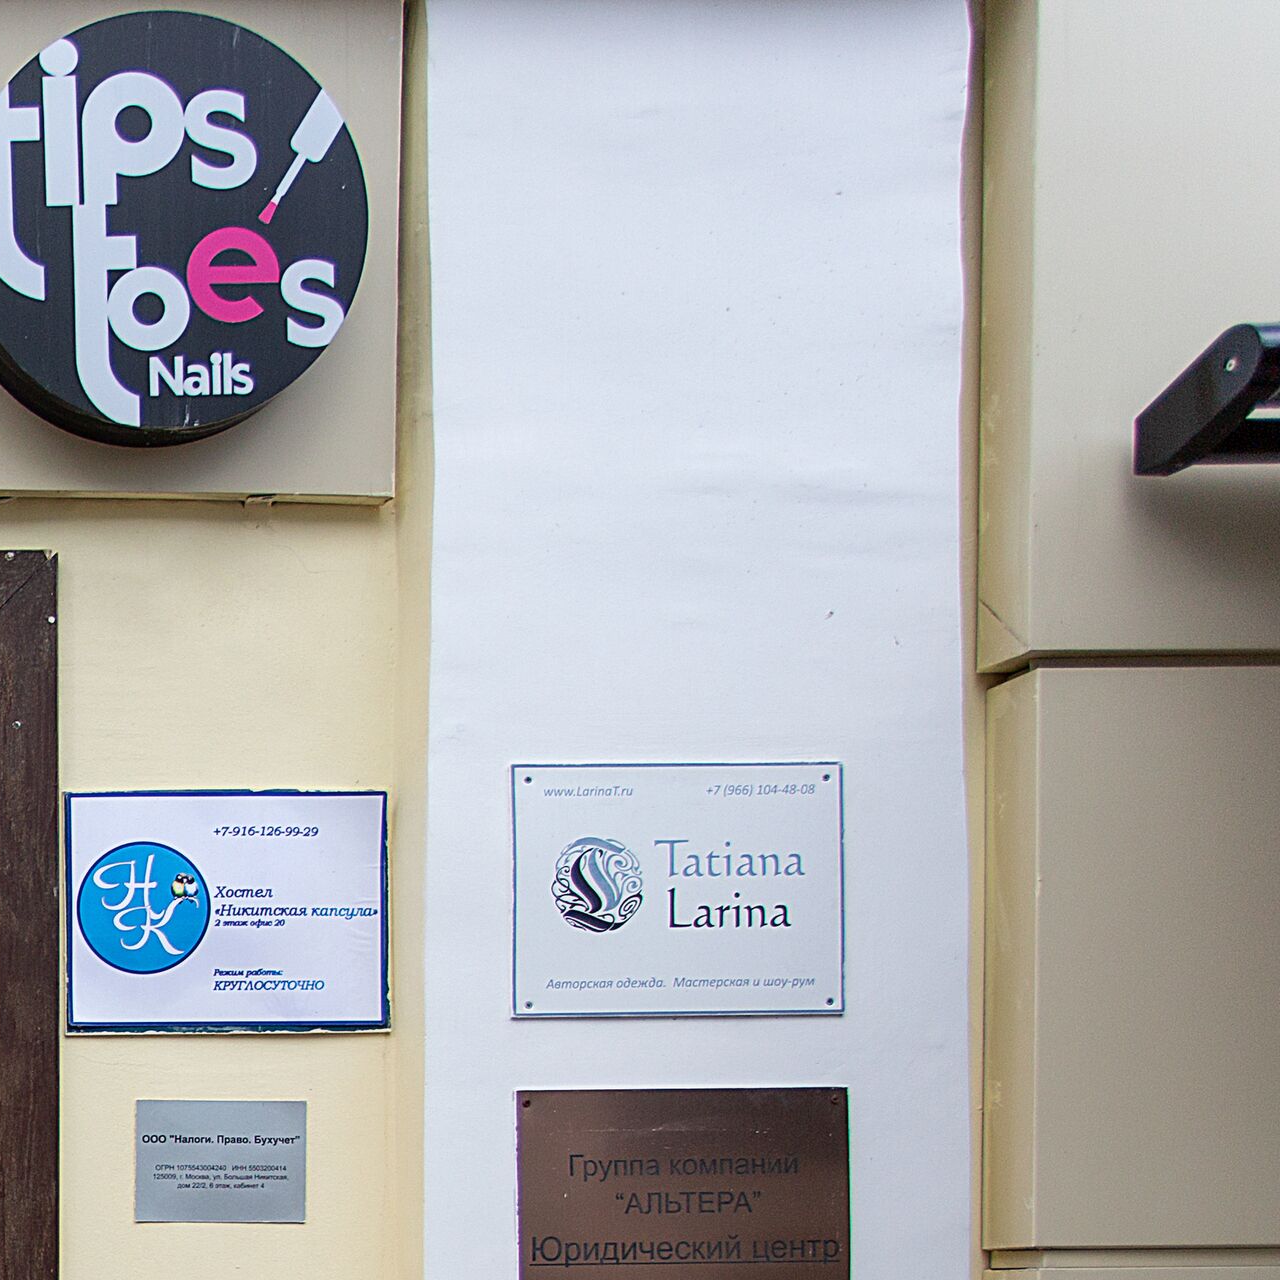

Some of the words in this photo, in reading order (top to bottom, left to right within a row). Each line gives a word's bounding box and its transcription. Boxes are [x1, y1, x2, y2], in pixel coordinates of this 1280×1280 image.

[72, 203, 345, 427] toes
[149, 353, 254, 397] Nails
[543, 787, 633, 797] www.LarinaT.ru
[706, 786, 721, 795] +7
[724, 785, 754, 797] (966)
[757, 784, 816, 796] 104-48-08
[213, 826, 319, 837] +7-916-126-99-29
[654, 839, 805, 878] Tatiana
[214, 886, 273, 898] Хостел
[215, 905, 307, 917] «Никитская
[311, 906, 378, 920] капсула»
[667, 887, 791, 928] Larina
[252, 919, 271, 928] офис
[213, 969, 243, 977] Режим
[245, 969, 283, 979] работы:
[213, 981, 324, 991] КРУГЛОСУТОЧНО
[546, 977, 613, 991] Авторская
[616, 978, 666, 989] одежда.
[673, 977, 750, 990] Мастерская
[753, 978, 760, 987] и
[763, 977, 815, 988] шоу-рум
[142, 1135, 166, 1143] ООО
[170, 1135, 214, 1144] "Налоги.
[217, 1135, 251, 1145] Право.
[255, 1136, 300, 1145] Бухучет"
[569, 1155, 660, 1182] Группа
[670, 1156, 799, 1175] компании
[531, 1234, 741, 1267] Юридический
[752, 1239, 840, 1264] центр
